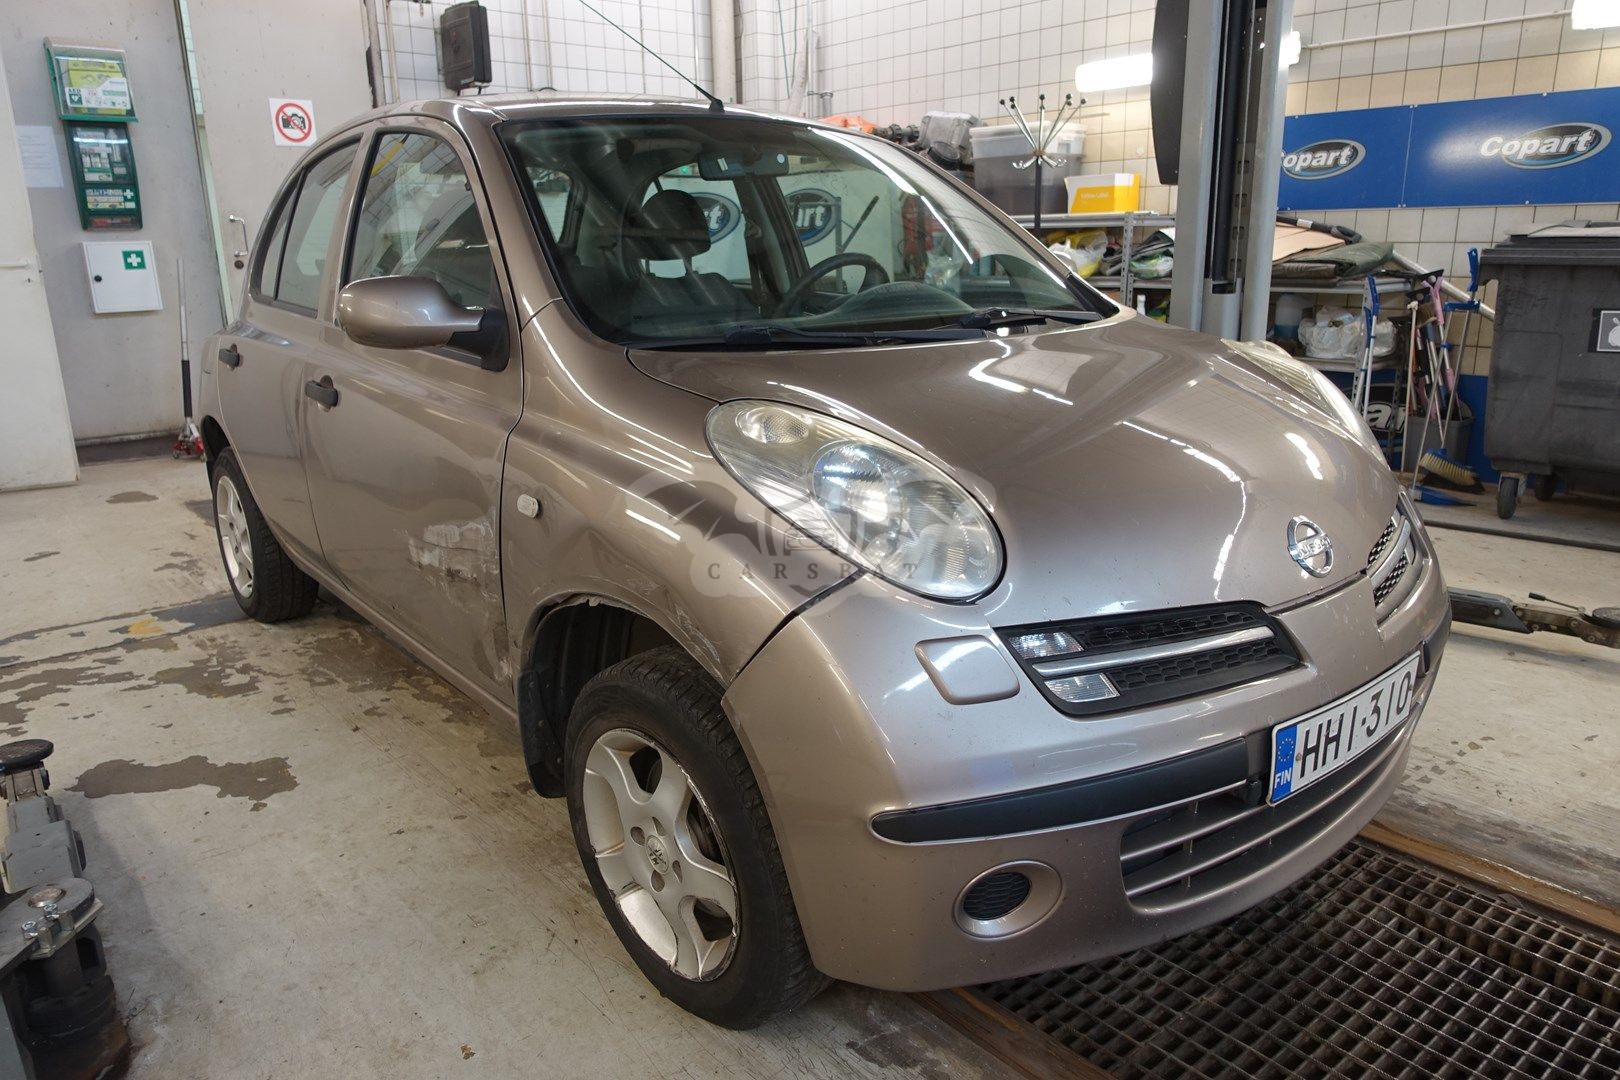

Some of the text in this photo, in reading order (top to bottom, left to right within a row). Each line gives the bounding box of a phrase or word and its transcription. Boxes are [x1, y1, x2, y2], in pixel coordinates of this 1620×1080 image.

[1281, 145, 1351, 171] opart
[1480, 129, 1594, 160] Copart
[1300, 671, 1411, 779] HHI-310
[1274, 768, 1292, 789] FIN
